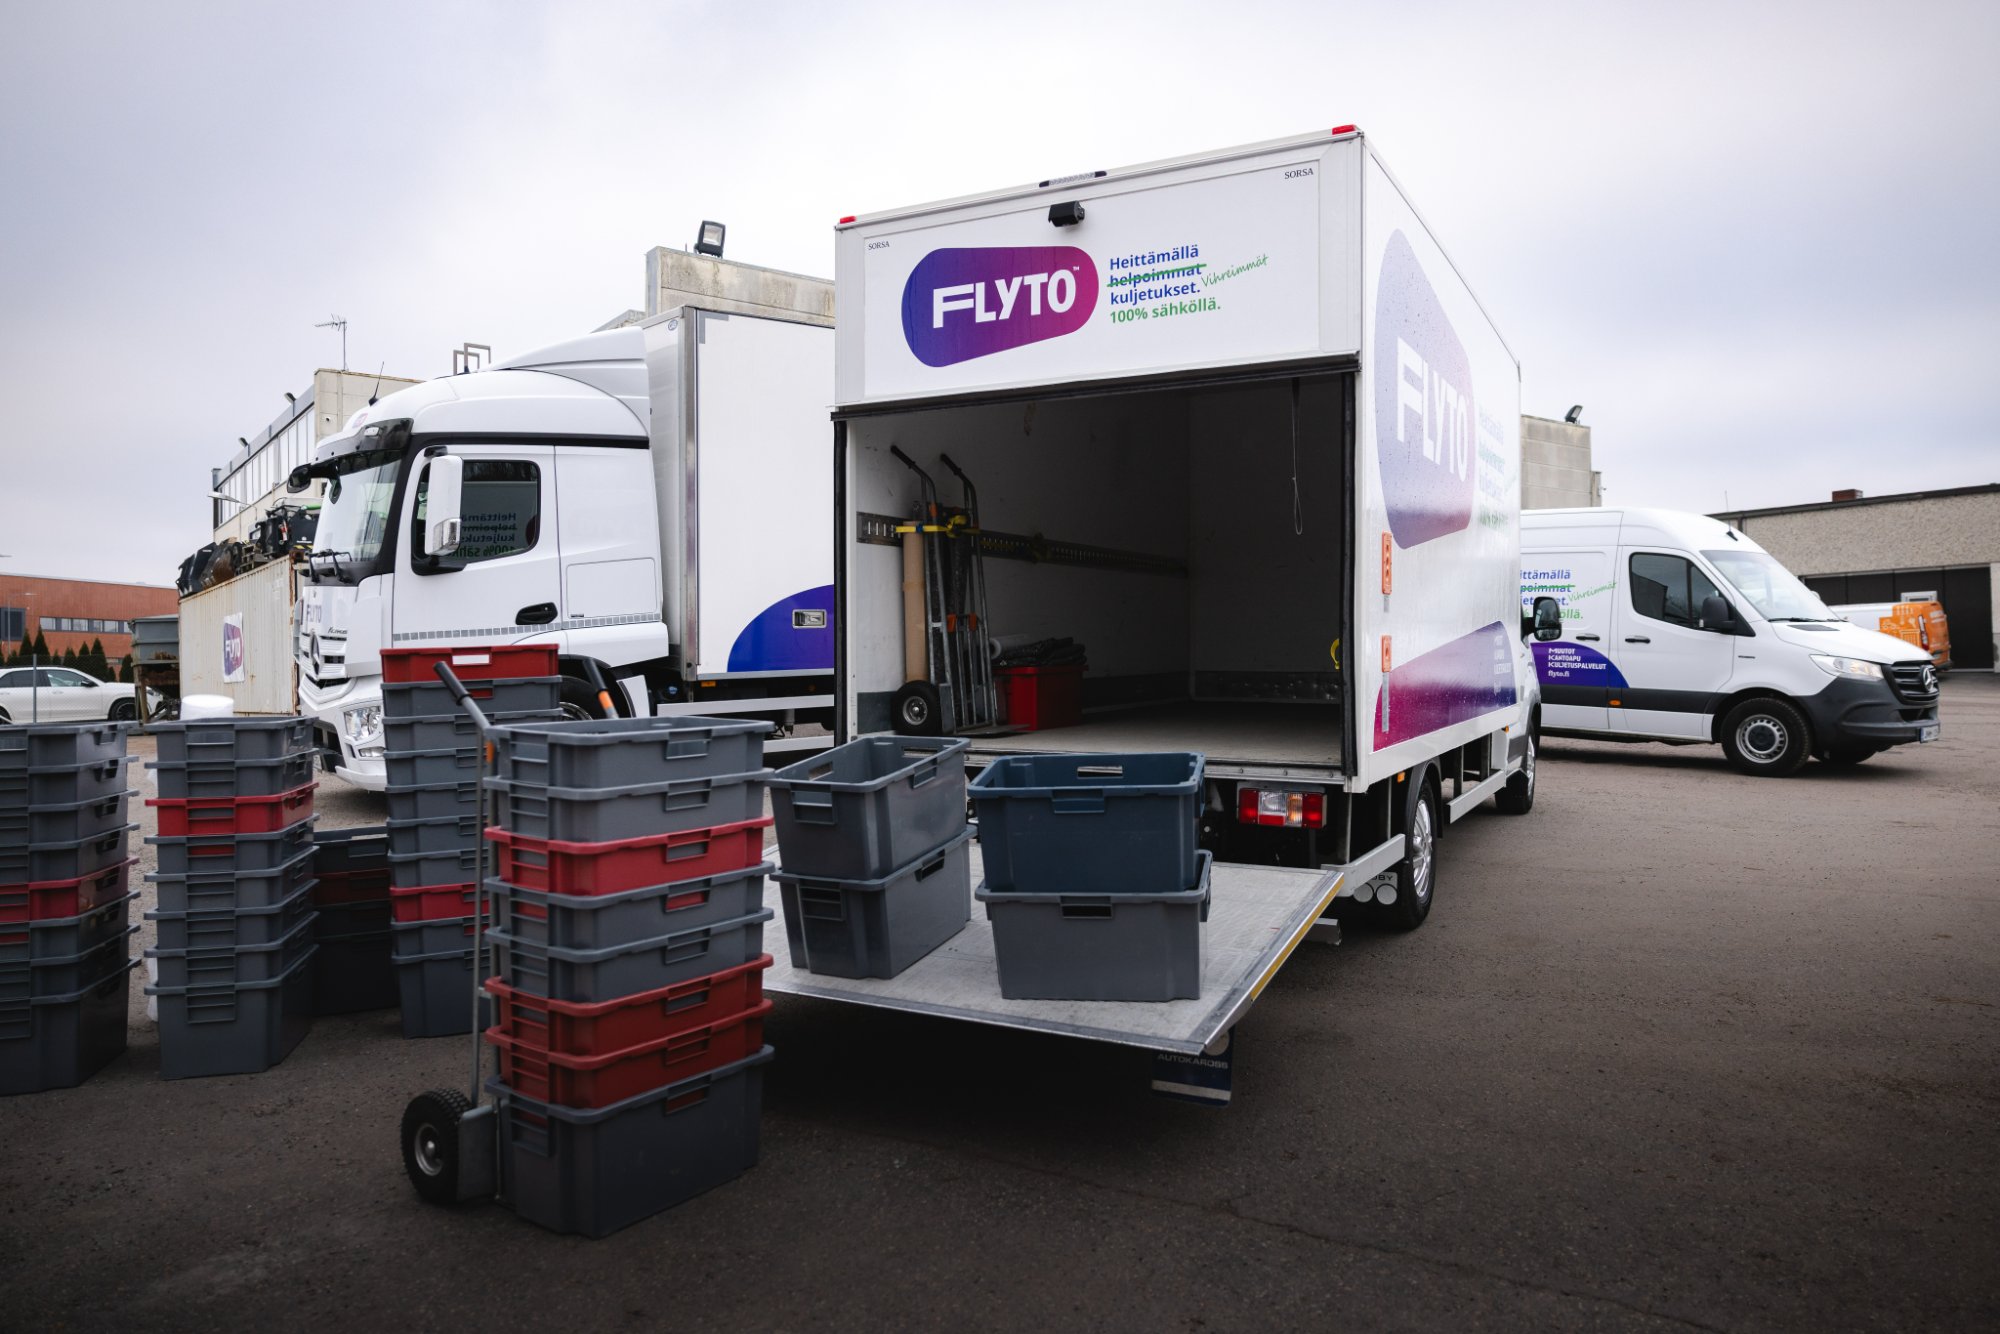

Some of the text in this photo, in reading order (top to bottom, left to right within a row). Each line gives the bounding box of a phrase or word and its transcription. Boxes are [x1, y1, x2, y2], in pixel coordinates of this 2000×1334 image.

[1284, 167, 1314, 180] SORSA
[868, 240, 890, 251] SORSA
[1110, 244, 1199, 270] Heittämällä
[1109, 264, 1202, 287] helpoimmat
[1201, 253, 1269, 288] Vihreimmät
[932, 269, 1077, 329] FLYTO
[1110, 282, 1201, 306] kuljetukset.
[1110, 297, 1221, 324] 100% sähköllä.
[1397, 336, 1469, 483] FLYTO
[1548, 654, 1581, 662] KANTOAPU
[1548, 661, 1607, 670] KULJETUSPALVELUT
[1548, 669, 1570, 678] flyto.fi
